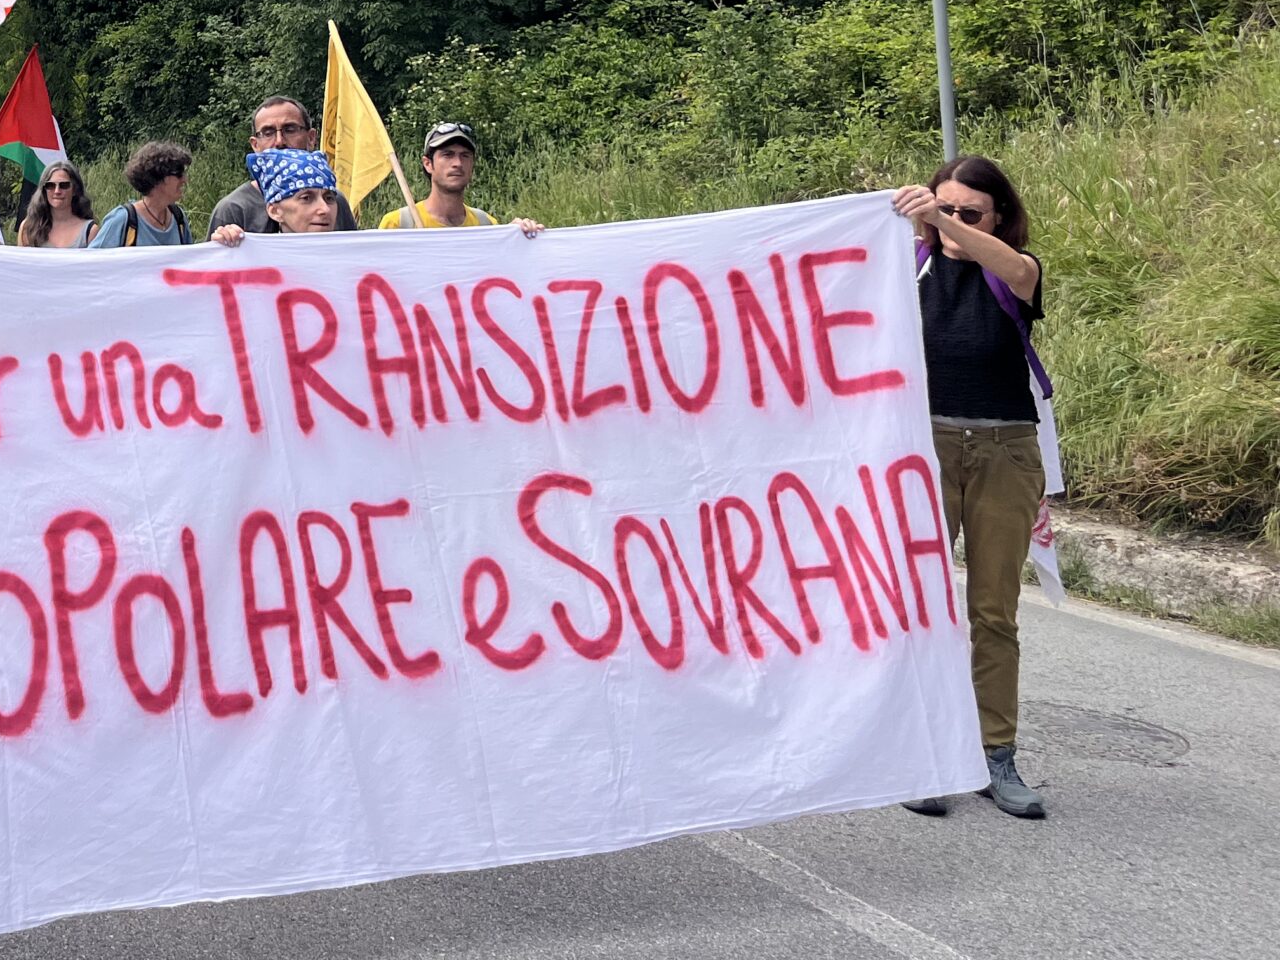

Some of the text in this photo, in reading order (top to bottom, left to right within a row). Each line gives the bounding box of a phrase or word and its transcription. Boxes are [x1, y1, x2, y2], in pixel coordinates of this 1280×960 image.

[47, 340, 223, 437] una
[162, 247, 906, 436] TRANSIZIONE
[461, 557, 547, 671] e
[517, 453, 958, 673] SOVRANA
